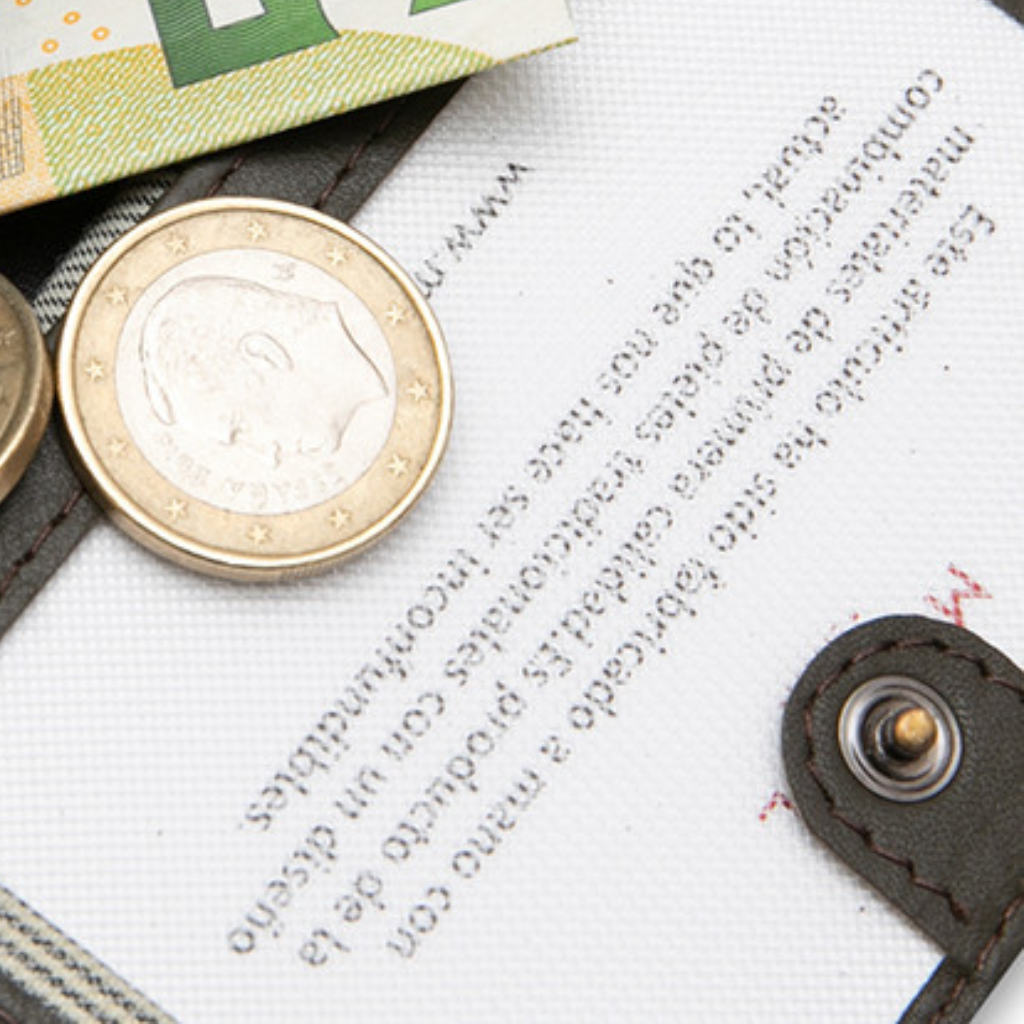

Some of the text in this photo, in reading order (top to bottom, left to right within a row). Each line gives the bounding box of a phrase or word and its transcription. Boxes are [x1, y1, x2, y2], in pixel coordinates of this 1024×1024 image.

[741, 95, 847, 210] actual,
[711, 213, 762, 254] lo
[825, 125, 976, 305] materiales
[924, 203, 996, 278] Este
[651, 256, 715, 326] que
[599, 328, 659, 396] nos
[785, 306, 833, 354] de
[527, 396, 613, 480] hace
[667, 352, 793, 501] primera
[772, 420, 829, 470] ha
[227, 68, 944, 956] combinación de pieles tradicionales con un diseño
[476, 484, 530, 549] ser
[708, 472, 778, 553] sido
[569, 557, 726, 731] fabricado
[381, 679, 527, 863] producto
[538, 735, 571, 764] a
[451, 768, 547, 880] mano
[333, 871, 387, 924] de
[386, 886, 452, 959] con
[298, 928, 351, 968] la
